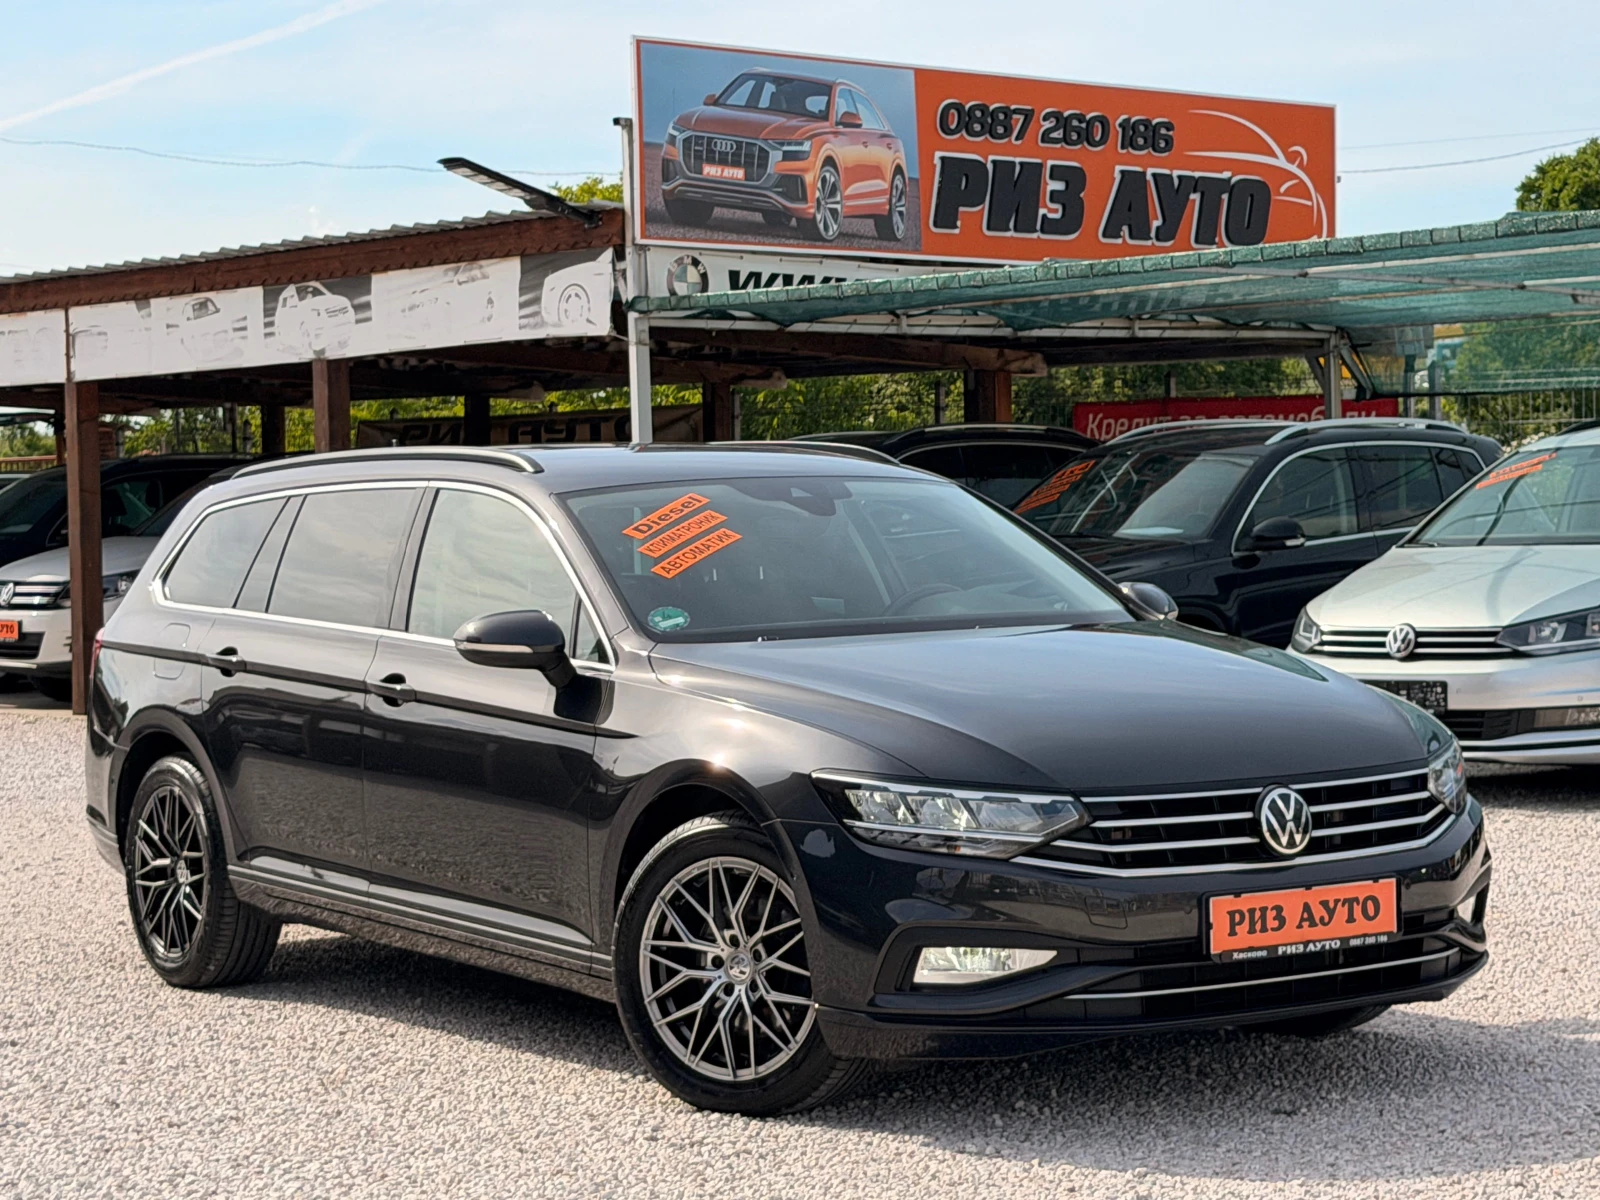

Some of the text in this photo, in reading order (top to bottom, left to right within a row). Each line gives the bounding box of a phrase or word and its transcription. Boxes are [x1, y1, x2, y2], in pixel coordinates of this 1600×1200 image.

[937, 99, 1176, 157] 0887 260 186
[929, 151, 1272, 249] РИЗ АУТО
[631, 495, 703, 535] Diesel
[644, 512, 720, 555] КЛИМАТРОНИК
[660, 531, 733, 575] АВТОМАТИК
[1226, 894, 1382, 937] РИЗ АУТО
[1277, 945, 1304, 956] РИЗ
[1306, 939, 1341, 953] АУТО
